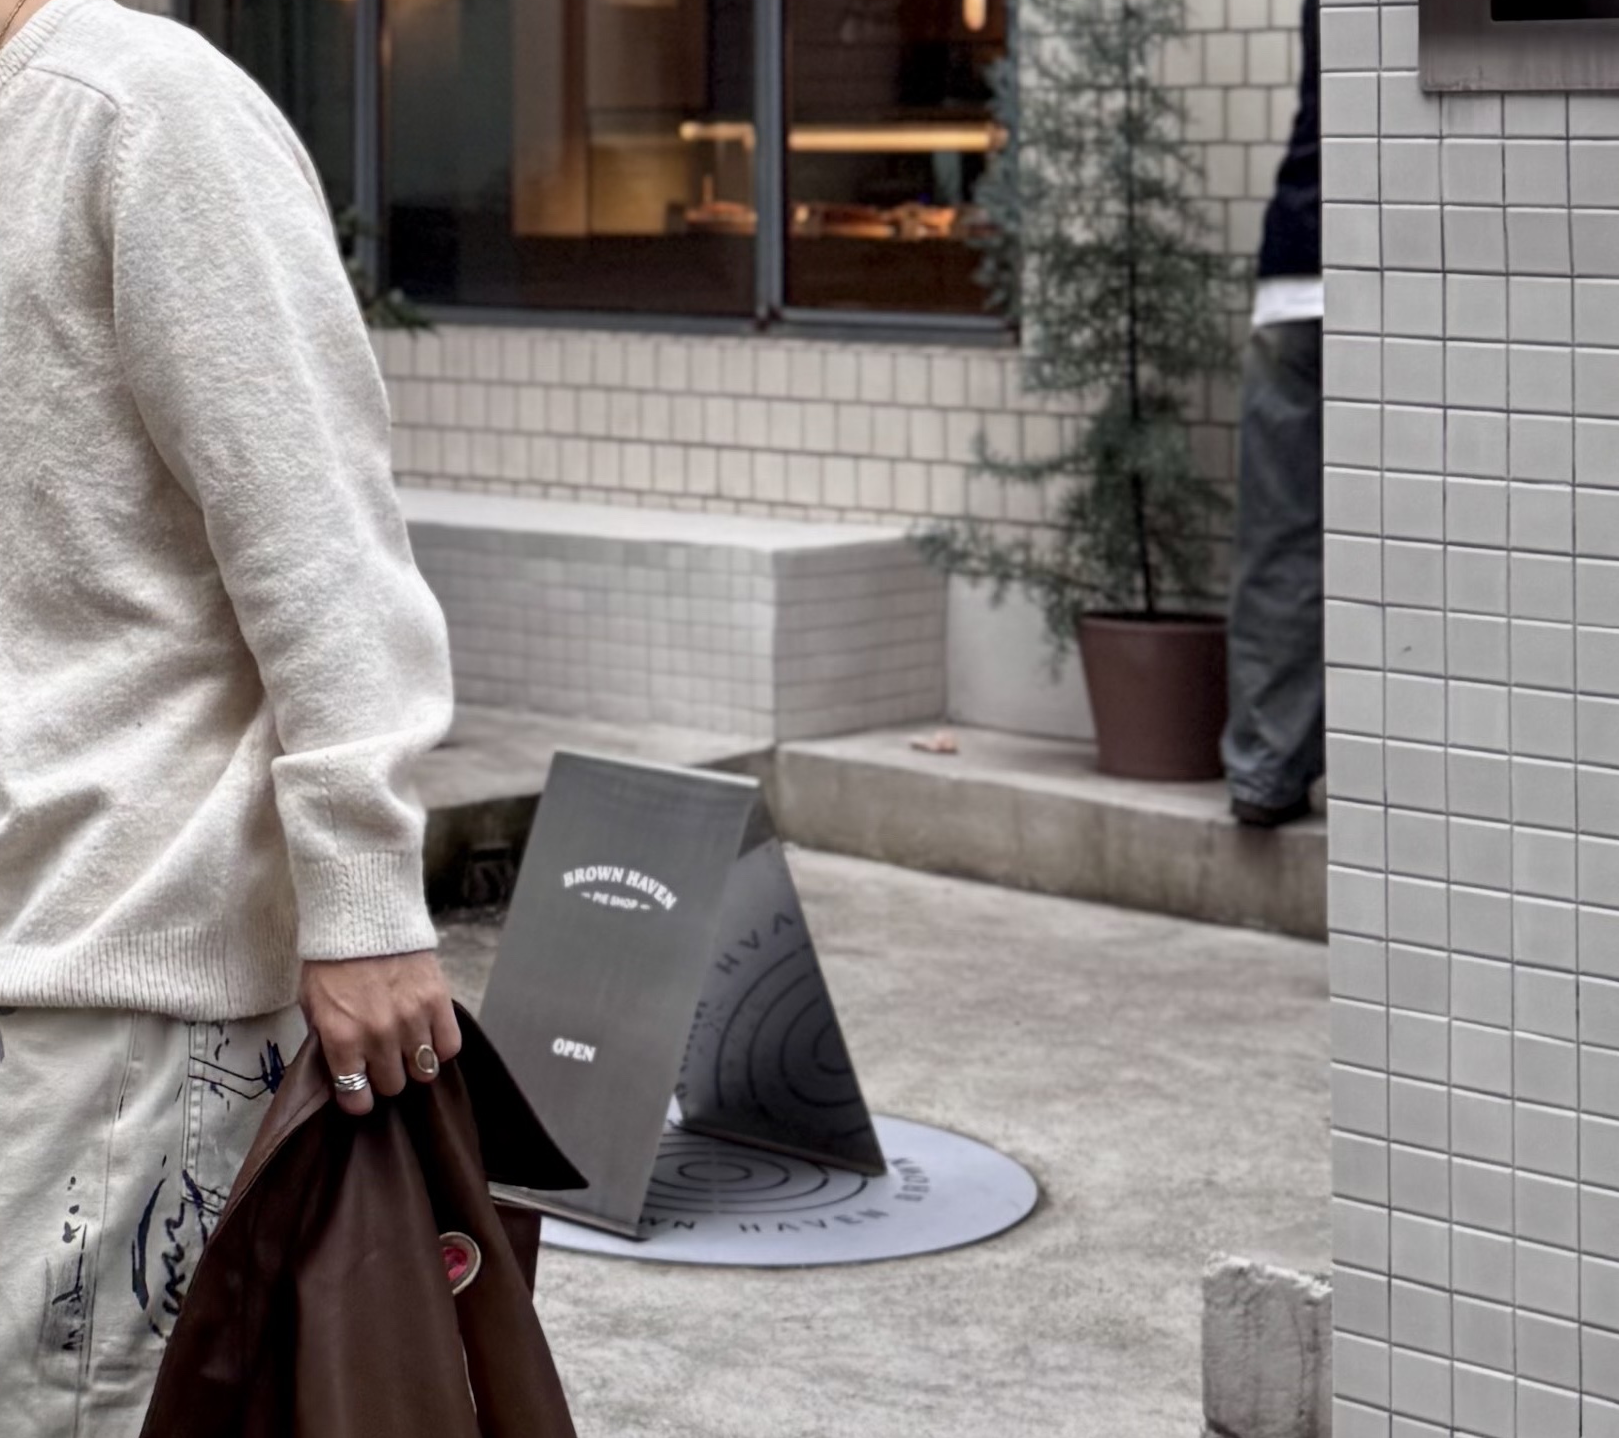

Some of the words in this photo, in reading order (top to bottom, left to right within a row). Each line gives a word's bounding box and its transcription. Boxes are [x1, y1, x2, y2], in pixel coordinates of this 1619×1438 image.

[563, 864, 624, 888] BROWN
[626, 869, 677, 910] HAVEN
[552, 1037, 596, 1062] OPEN
[739, 1208, 889, 1234] HAVEN
